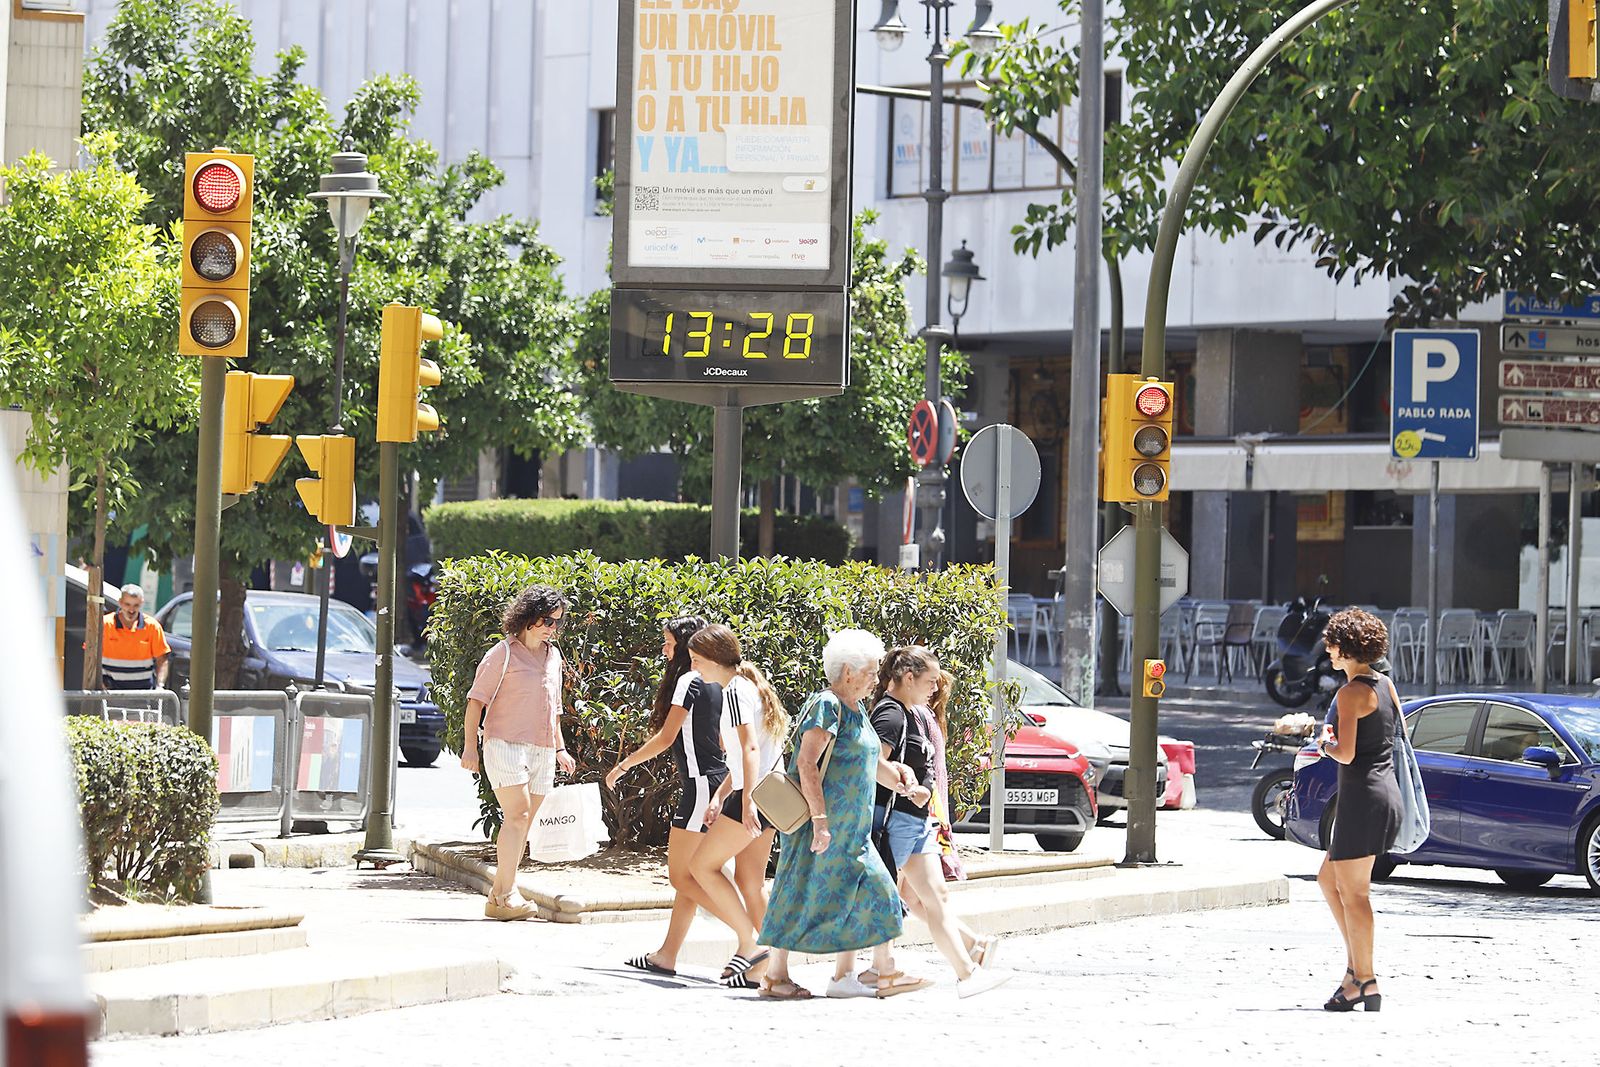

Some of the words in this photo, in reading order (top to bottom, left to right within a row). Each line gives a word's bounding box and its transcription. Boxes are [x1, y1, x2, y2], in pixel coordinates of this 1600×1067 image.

[639, 14, 677, 50] UN
[688, 9, 782, 51] MÓVIL
[638, 55, 657, 91] A
[667, 55, 701, 91] TU
[712, 55, 780, 92] HIJO
[637, 95, 656, 132] O
[666, 96, 685, 132] A
[696, 96, 730, 132] TU
[740, 96, 807, 125] HIJA
[636, 136, 654, 173] Y
[675, 186, 695, 194] móvil
[753, 187, 773, 195] móvil
[662, 311, 815, 359] 13:28
[703, 368, 748, 377] JCDecaux
[1411, 338, 1460, 403] P
[1398, 407, 1436, 418] PABLO
[1440, 408, 1472, 419] RADA
[1007, 791, 1034, 802] 9593
[1037, 791, 1055, 802] MGP
[540, 815, 576, 827] MANGO
